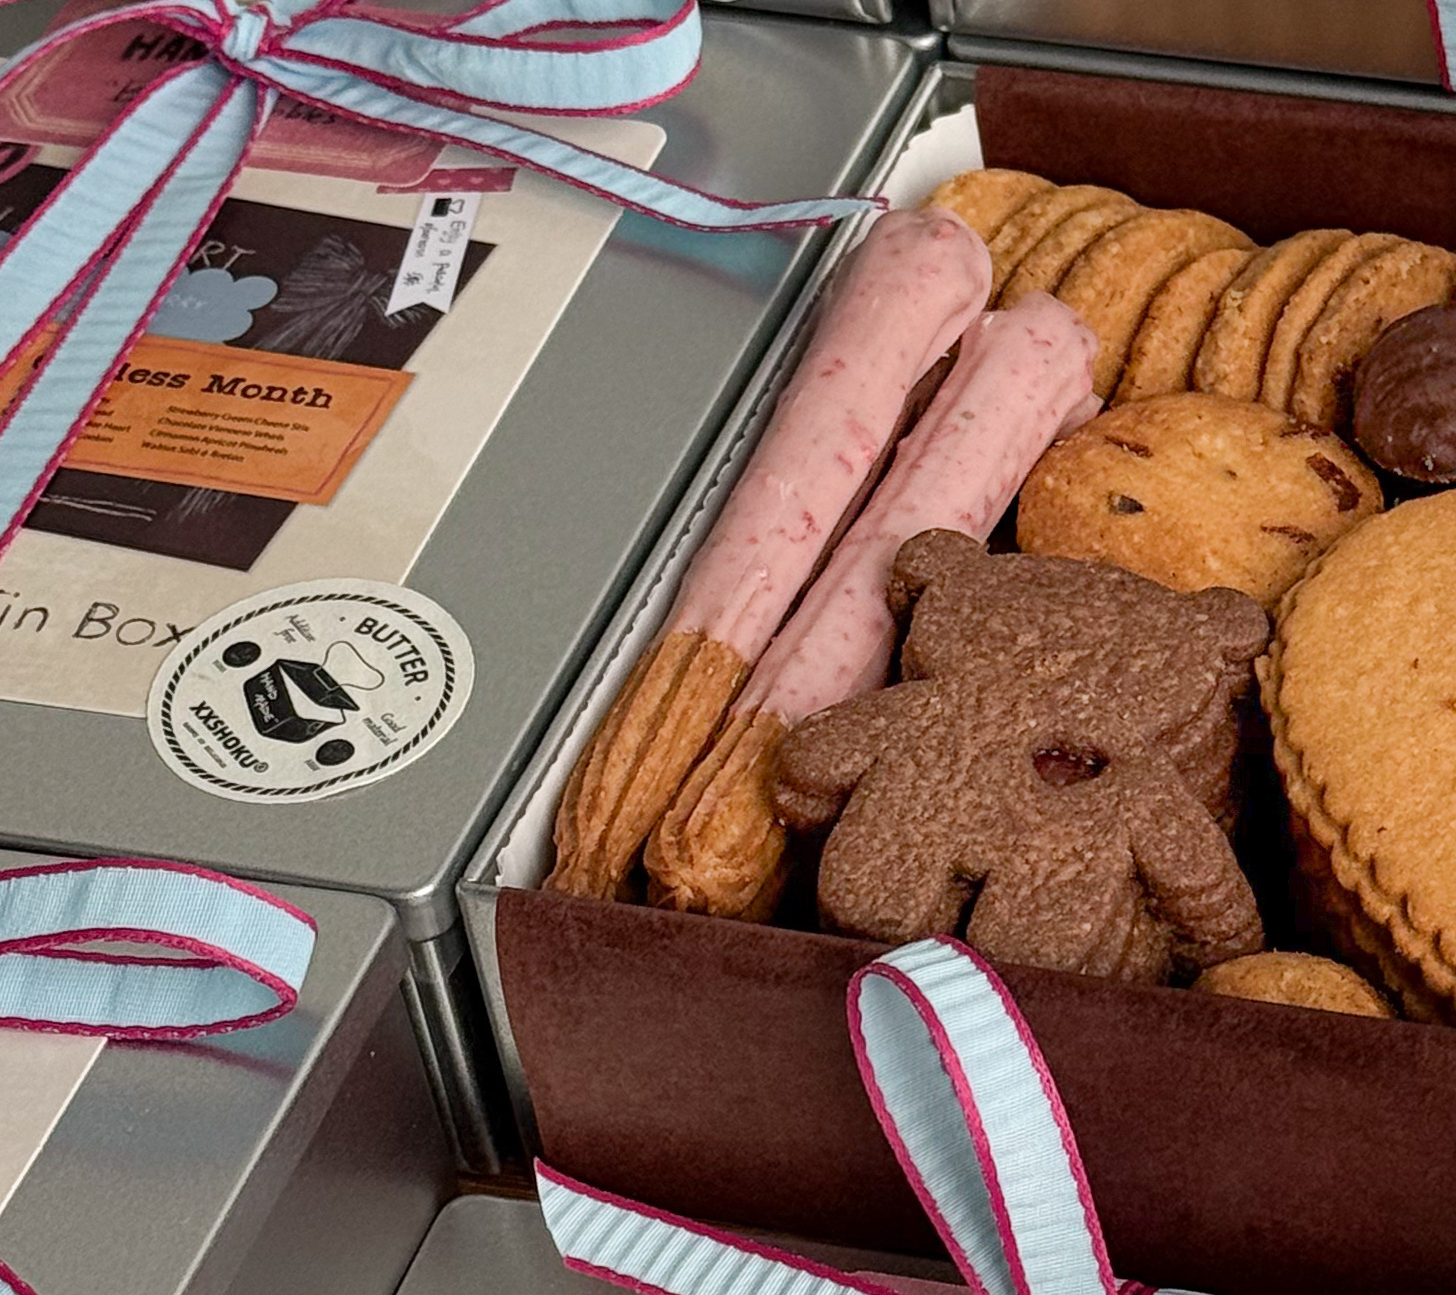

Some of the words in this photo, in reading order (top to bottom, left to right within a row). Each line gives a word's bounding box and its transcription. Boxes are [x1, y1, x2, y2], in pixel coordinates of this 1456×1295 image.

[200, 373, 334, 411] Month
[72, 601, 197, 648] Box
[353, 616, 430, 687] BUTTER
